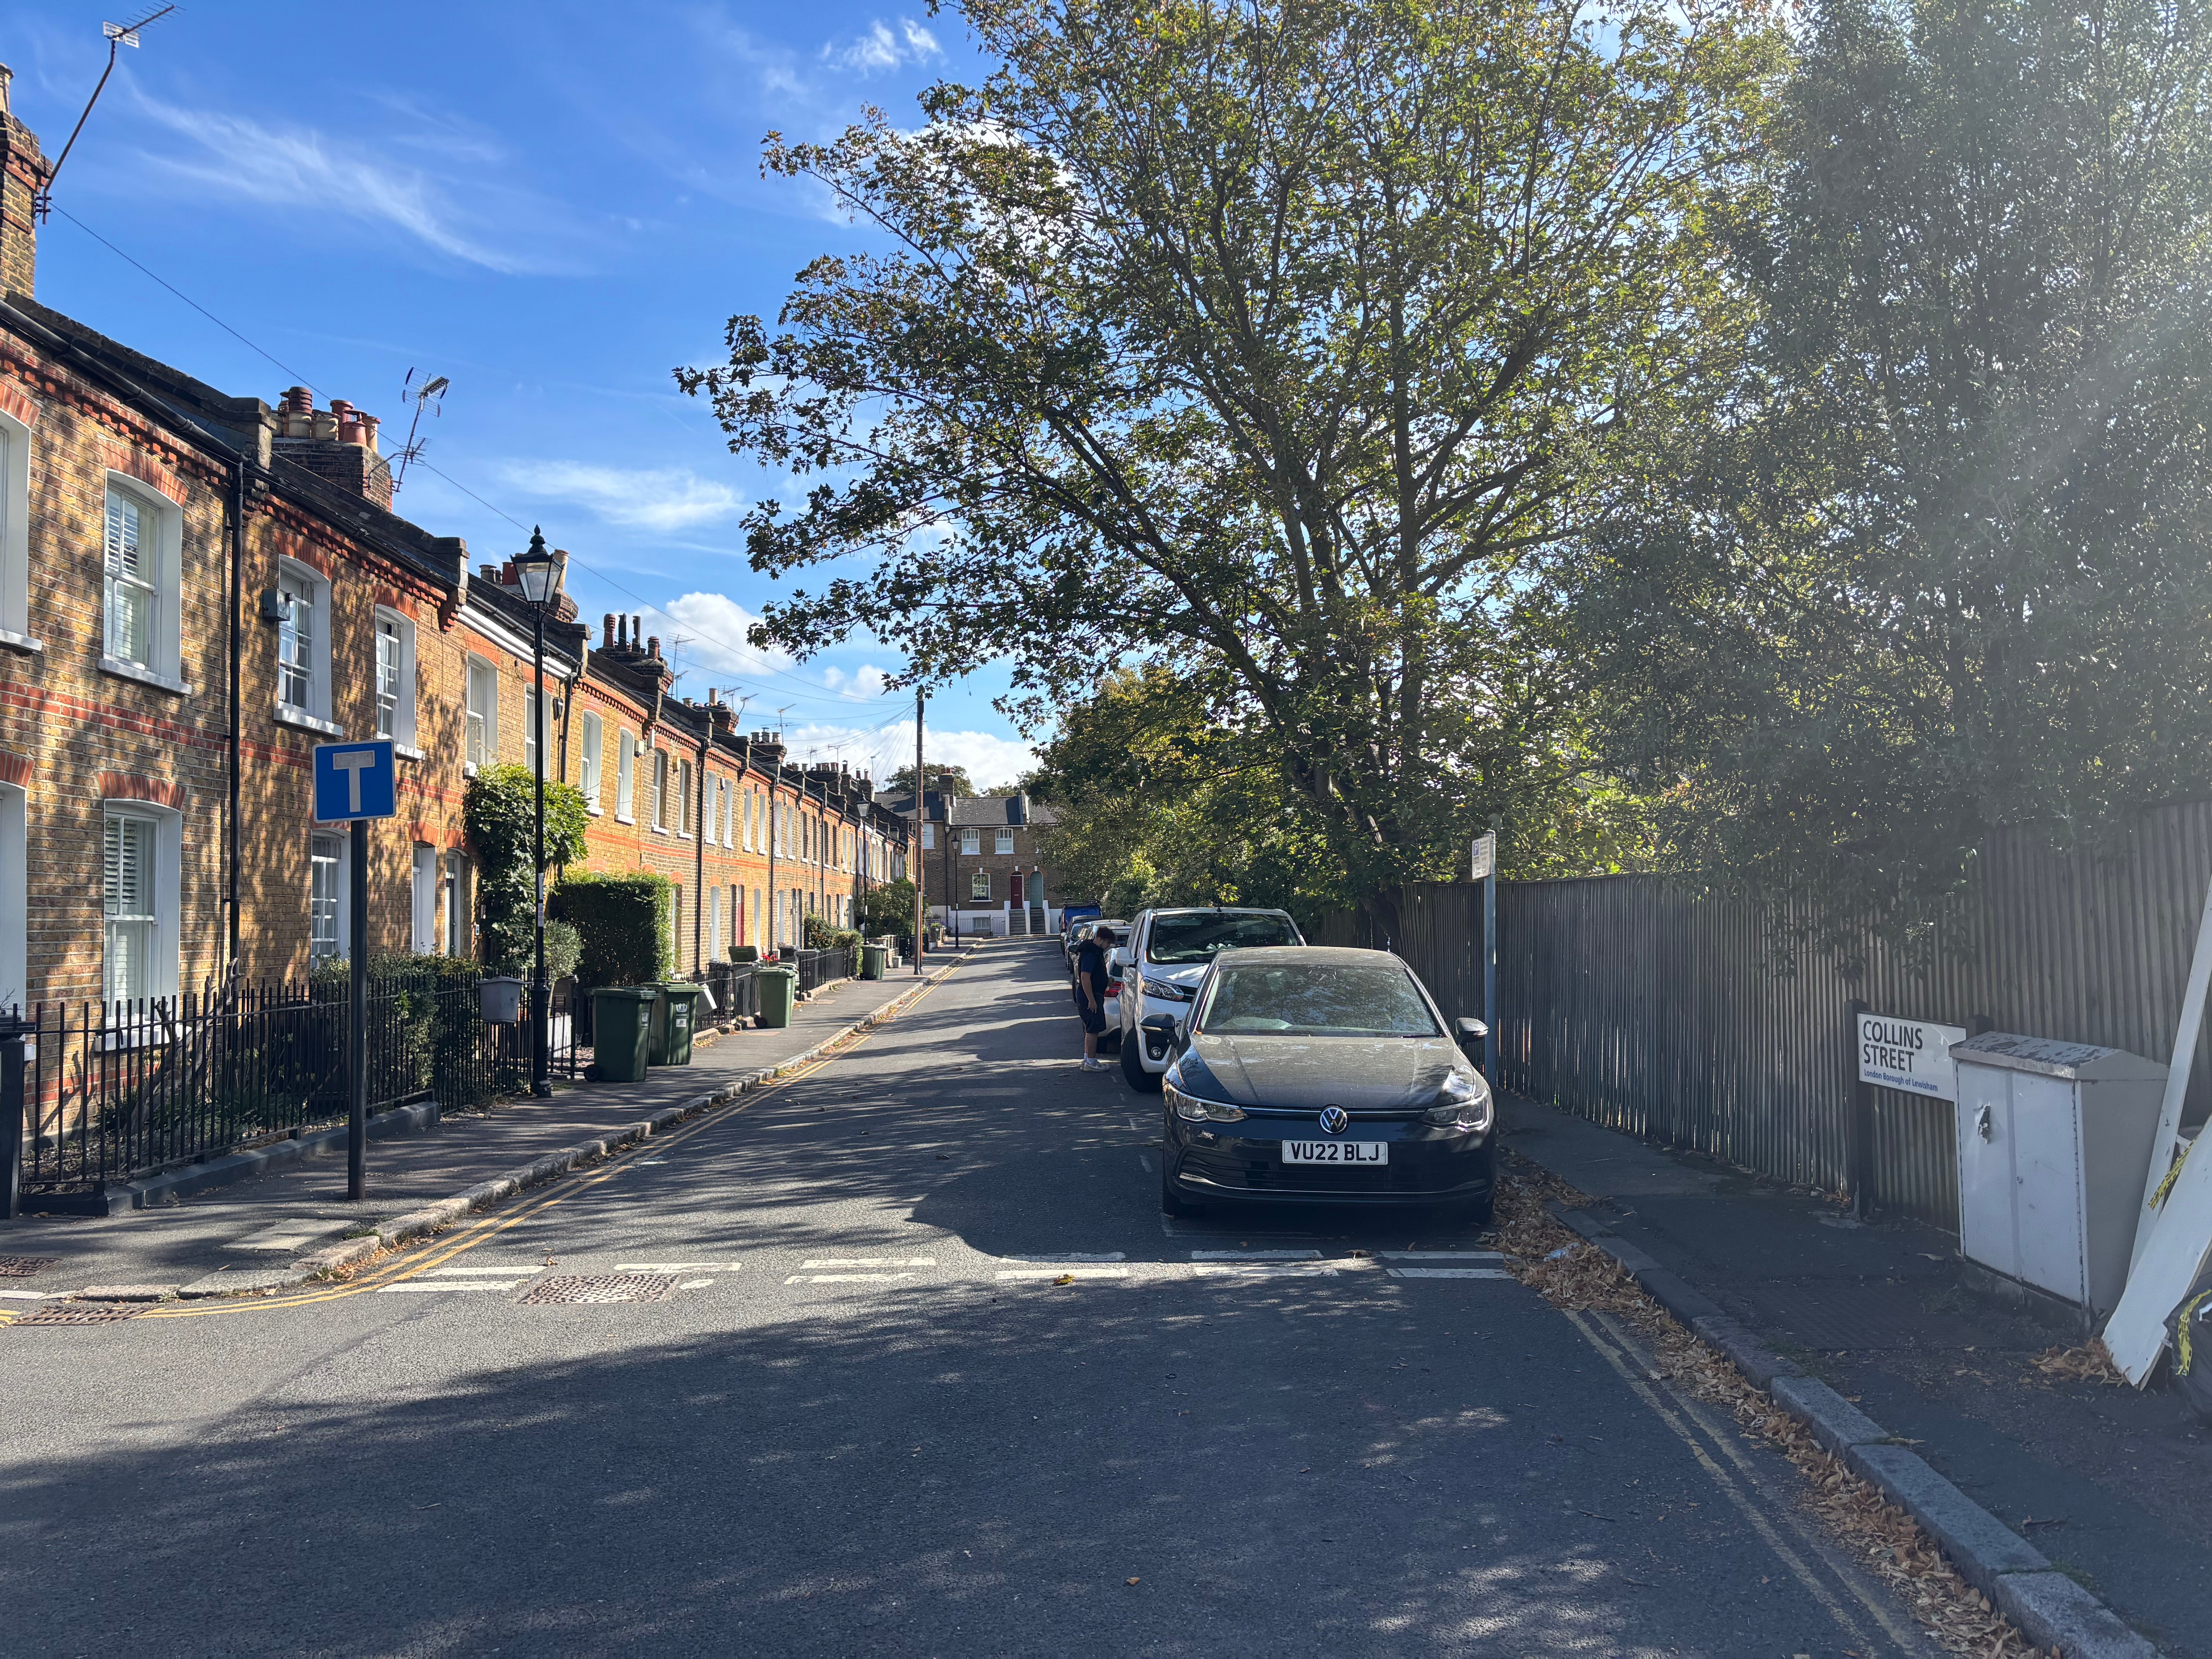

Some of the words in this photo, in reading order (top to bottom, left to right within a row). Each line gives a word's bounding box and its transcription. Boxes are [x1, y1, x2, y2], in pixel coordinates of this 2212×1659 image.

[1863, 1020, 1923, 1049] COLLINS
[1863, 1043, 1914, 1072] STREET
[1864, 1069, 1882, 1079] London
[1883, 1072, 1904, 1085] Borough
[1905, 1077, 1911, 1085] of
[1912, 1079, 1938, 1091] Lewisham
[1291, 1143, 1338, 1161] VU22
[1344, 1144, 1379, 1161] BLJ
